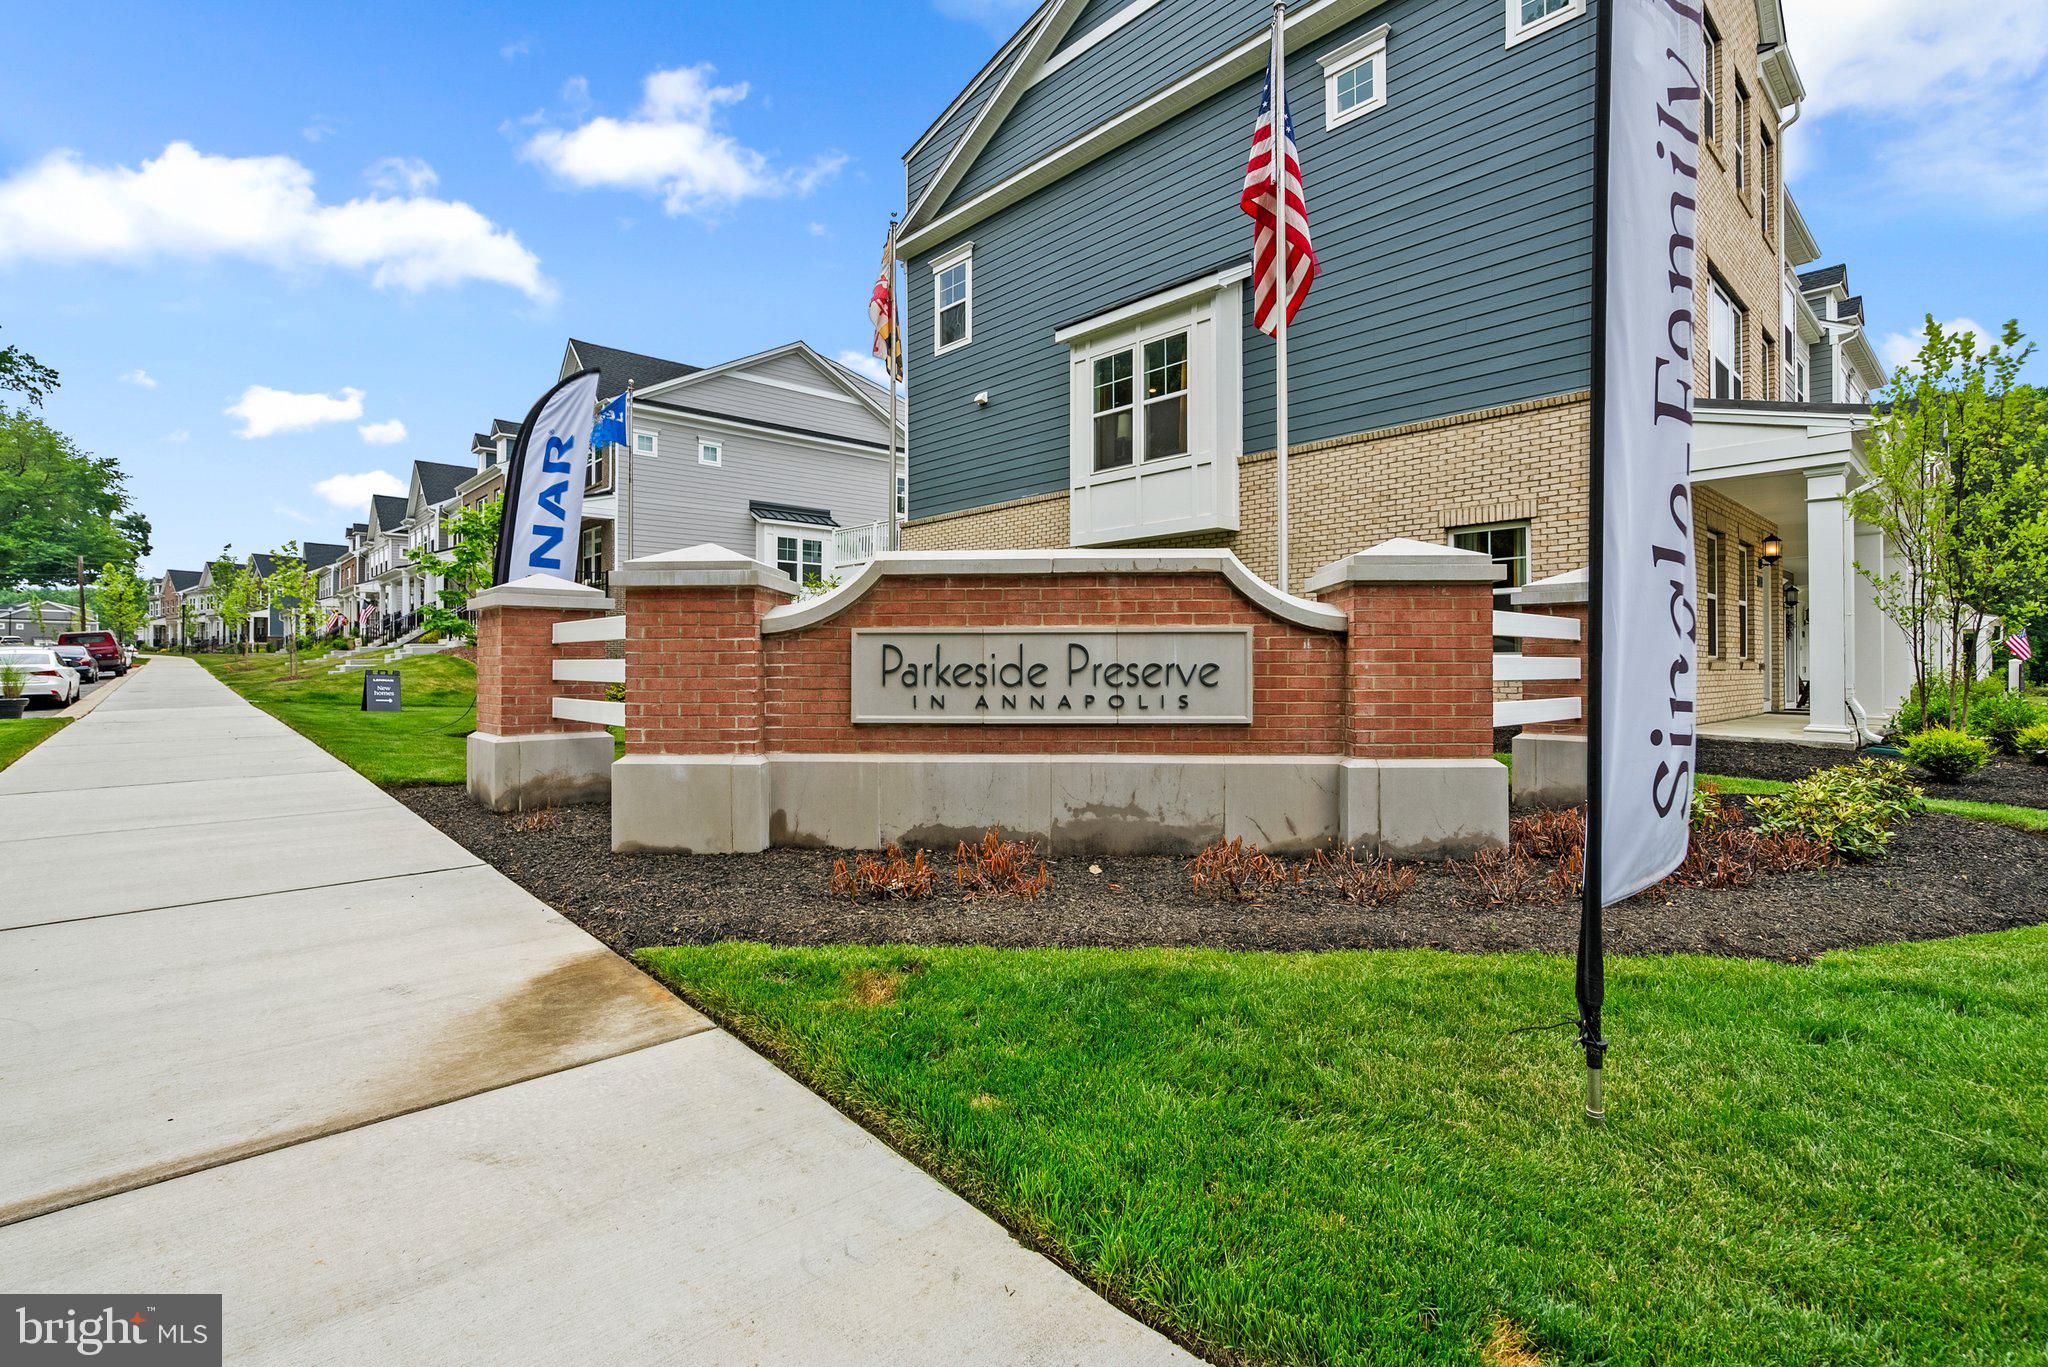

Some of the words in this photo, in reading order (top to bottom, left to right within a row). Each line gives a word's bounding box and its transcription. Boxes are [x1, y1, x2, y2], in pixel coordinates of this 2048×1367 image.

[528, 434, 574, 571] NAR
[881, 643, 1048, 689] Parkeside
[1067, 643, 1220, 688] Preserve
[913, 695, 945, 709] IN
[975, 694, 1189, 710] ANNAPOLIS
